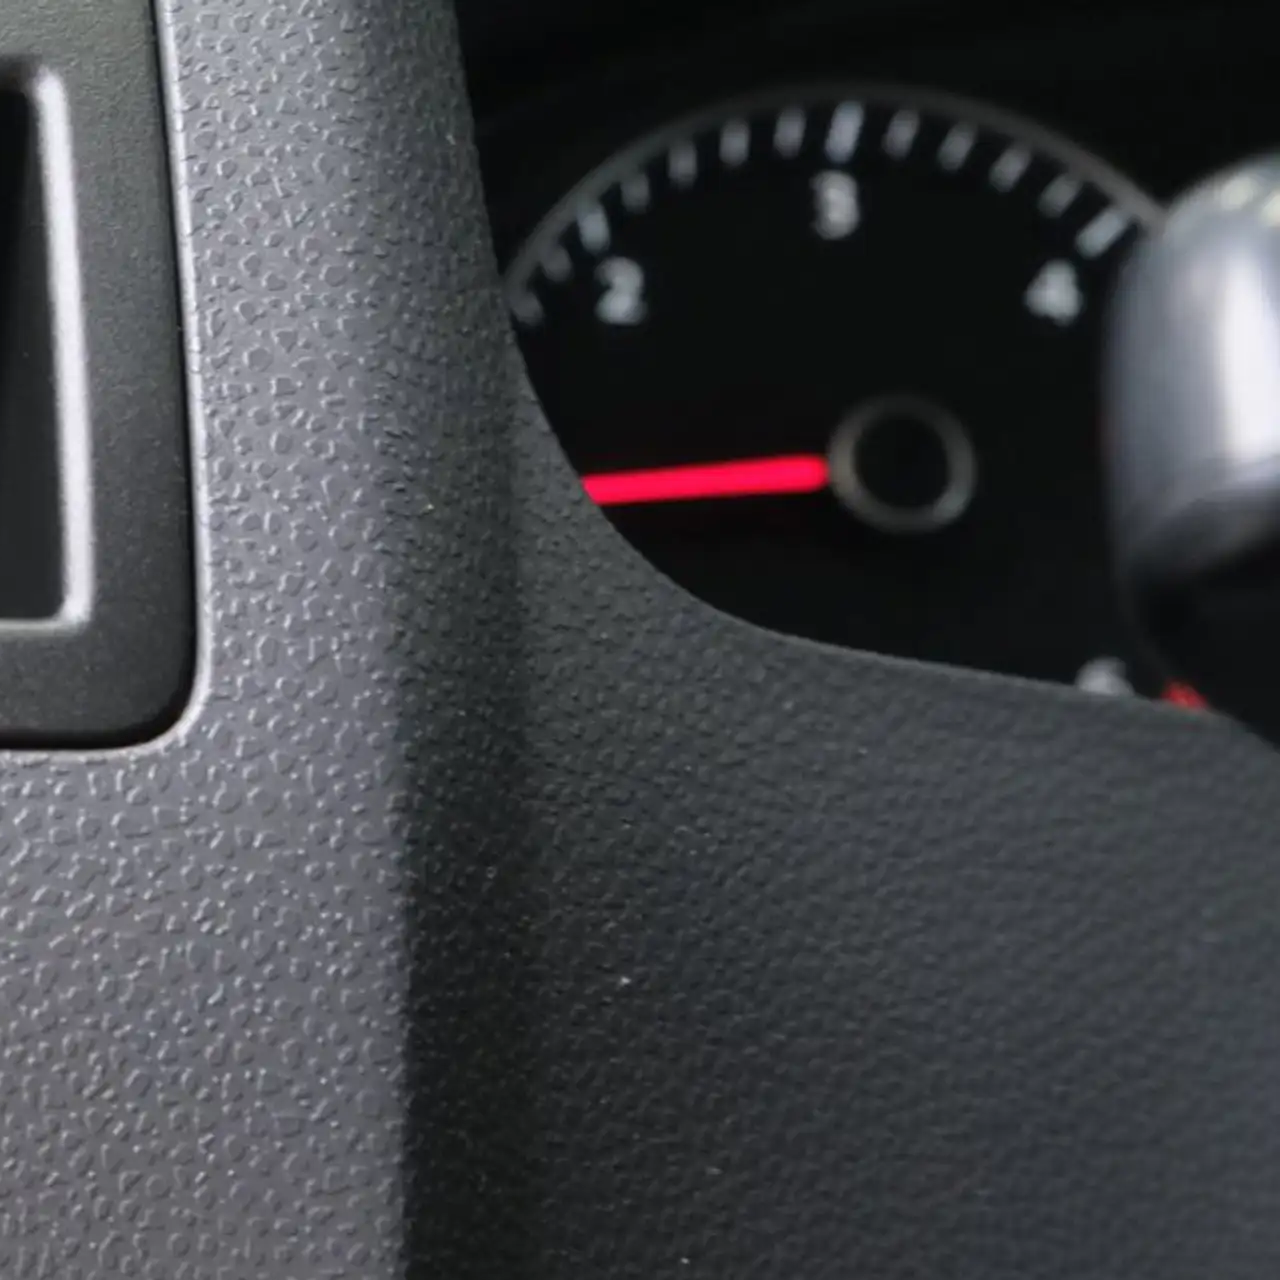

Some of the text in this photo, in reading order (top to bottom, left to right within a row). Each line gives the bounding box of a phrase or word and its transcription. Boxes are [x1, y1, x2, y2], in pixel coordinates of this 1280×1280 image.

[816, 171, 859, 239] 3
[597, 257, 644, 324] 2
[1026, 260, 1082, 322] 4
